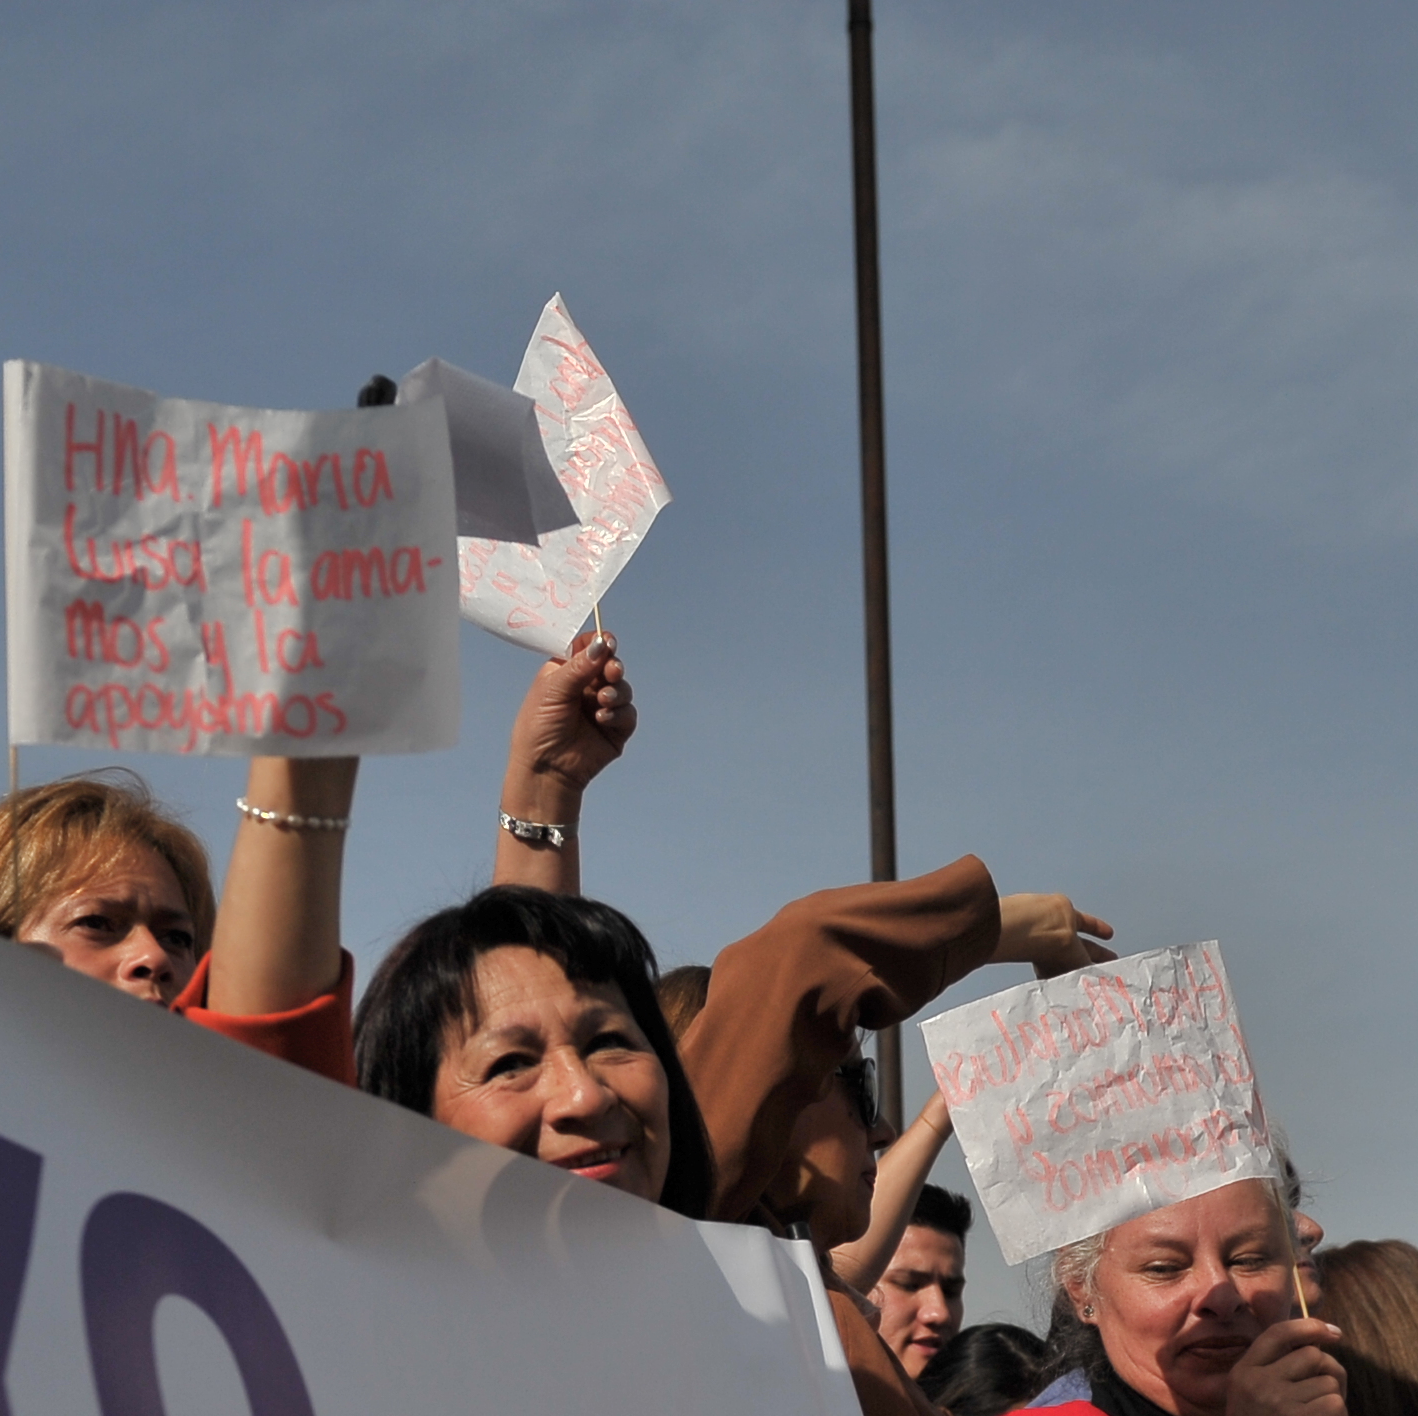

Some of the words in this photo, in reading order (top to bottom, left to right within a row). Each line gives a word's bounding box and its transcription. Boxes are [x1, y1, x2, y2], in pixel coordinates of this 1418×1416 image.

[64, 502, 209, 594] Luisa
[241, 518, 300, 608] la
[64, 597, 171, 674] mos
[200, 618, 234, 698] y
[253, 608, 326, 675] la
[64, 683, 348, 753] apoyamos
